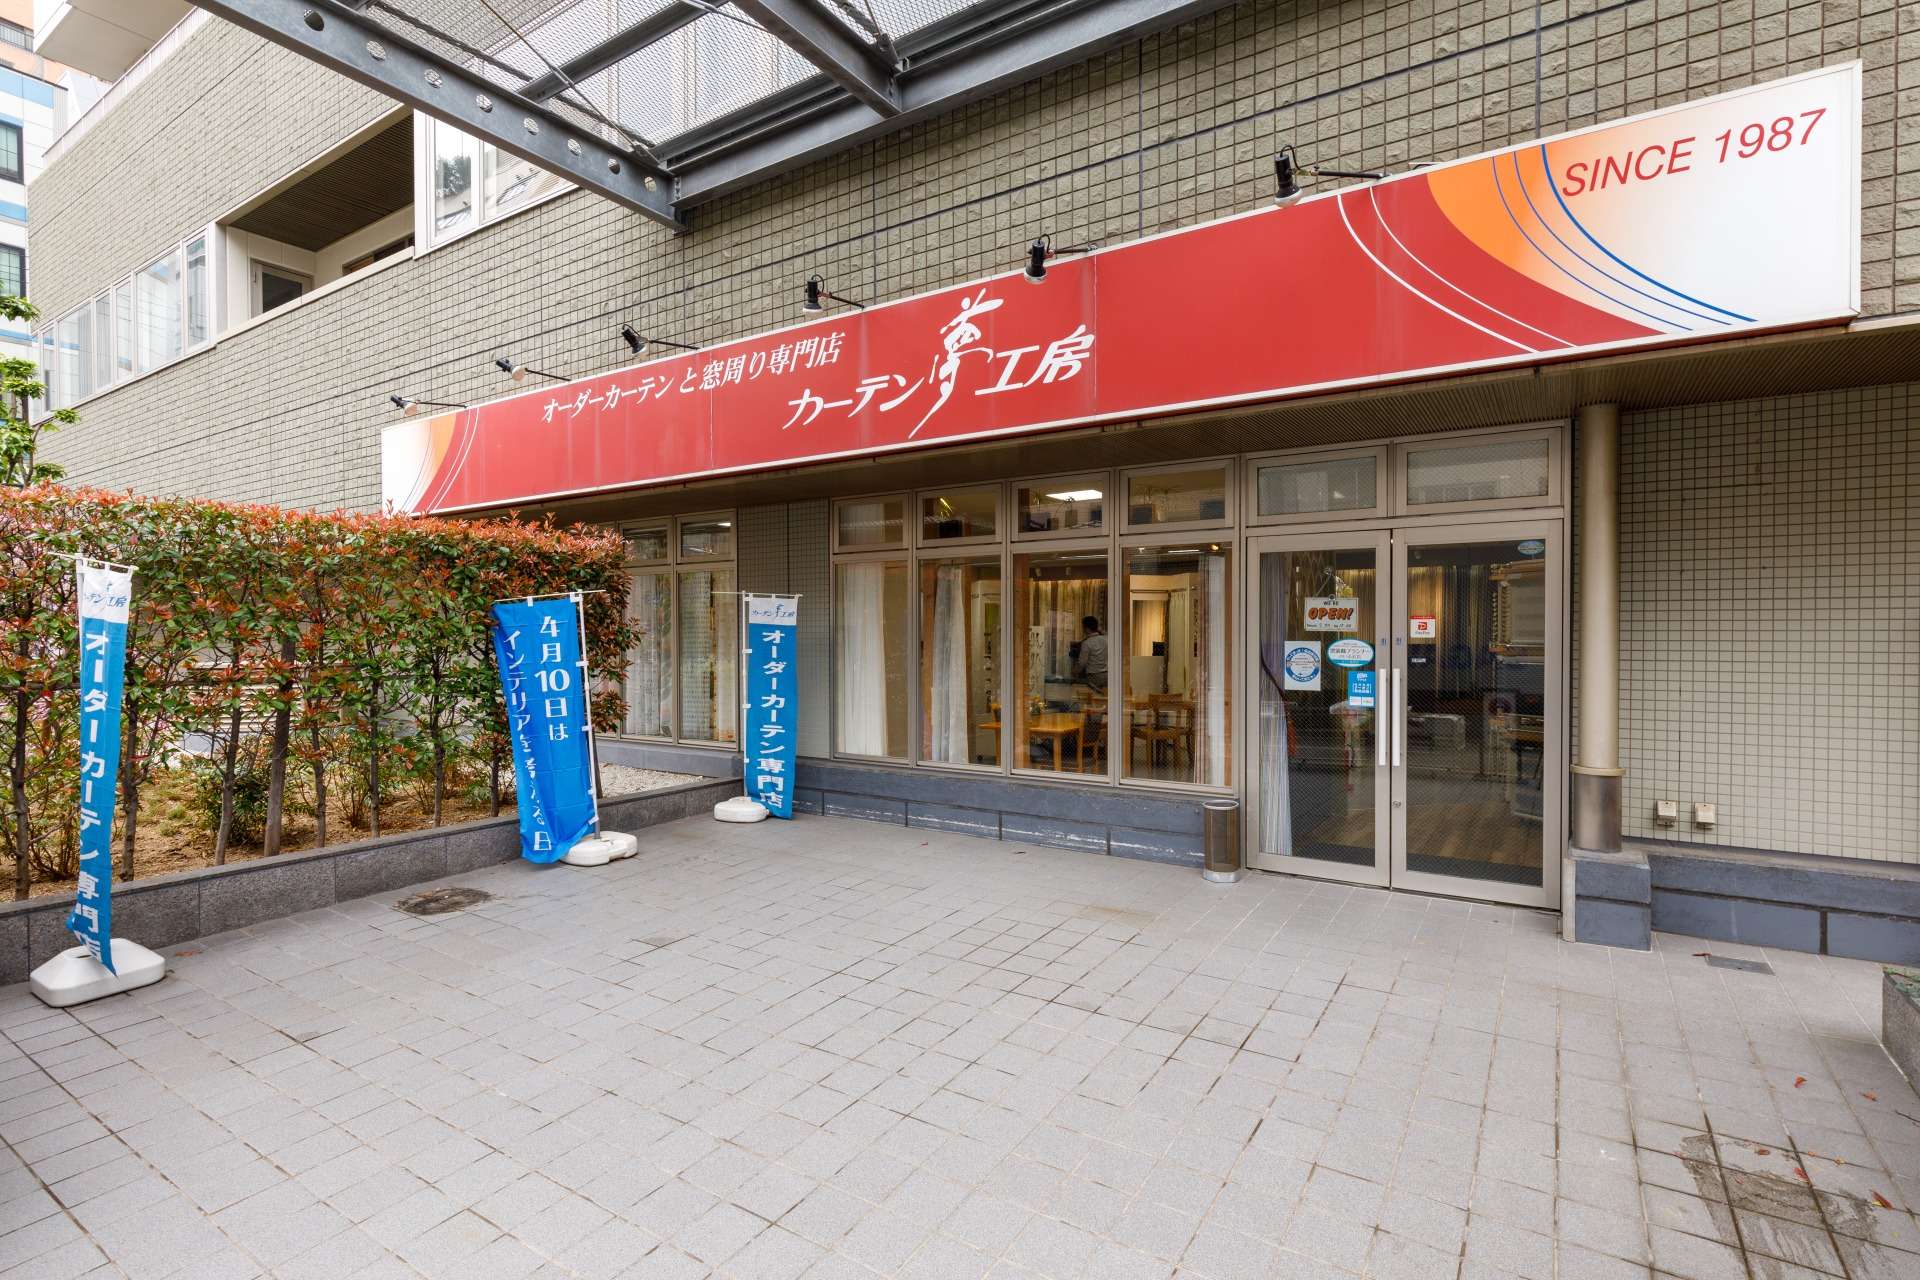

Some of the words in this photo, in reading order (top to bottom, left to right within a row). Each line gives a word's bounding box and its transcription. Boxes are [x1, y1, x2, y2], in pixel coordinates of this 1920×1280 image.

[1562, 136, 1696, 197] SINCE
[1714, 107, 1827, 163] 1987
[541, 331, 847, 424] オーダーカーテンと窓周り専門店
[782, 287, 1096, 439] カーテン夢工房
[1308, 607, 1354, 620] OPEN!
[534, 615, 571, 741] 4月10日は
[756, 629, 787, 809] オーダーカーテン専門店
